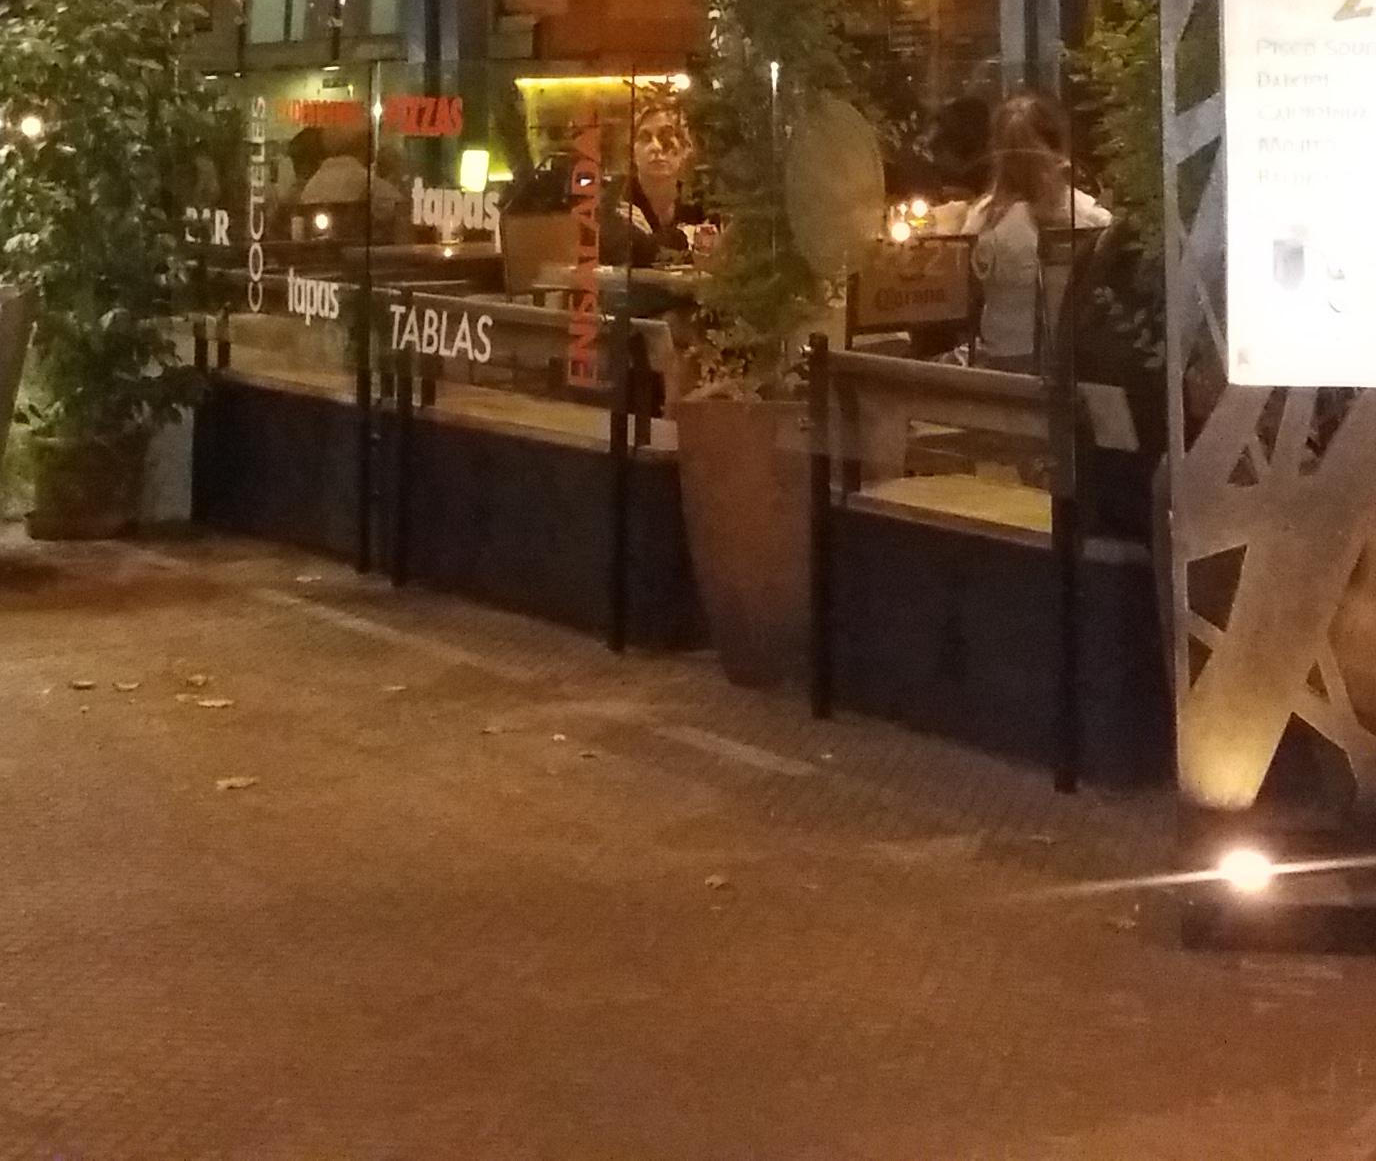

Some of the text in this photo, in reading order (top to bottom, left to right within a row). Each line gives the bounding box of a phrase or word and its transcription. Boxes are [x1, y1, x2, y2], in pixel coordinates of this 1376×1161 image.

[248, 95, 266, 313] COCTELES
[411, 175, 501, 245] tapas
[287, 265, 340, 327] tapas
[389, 303, 494, 364] TABLAS
